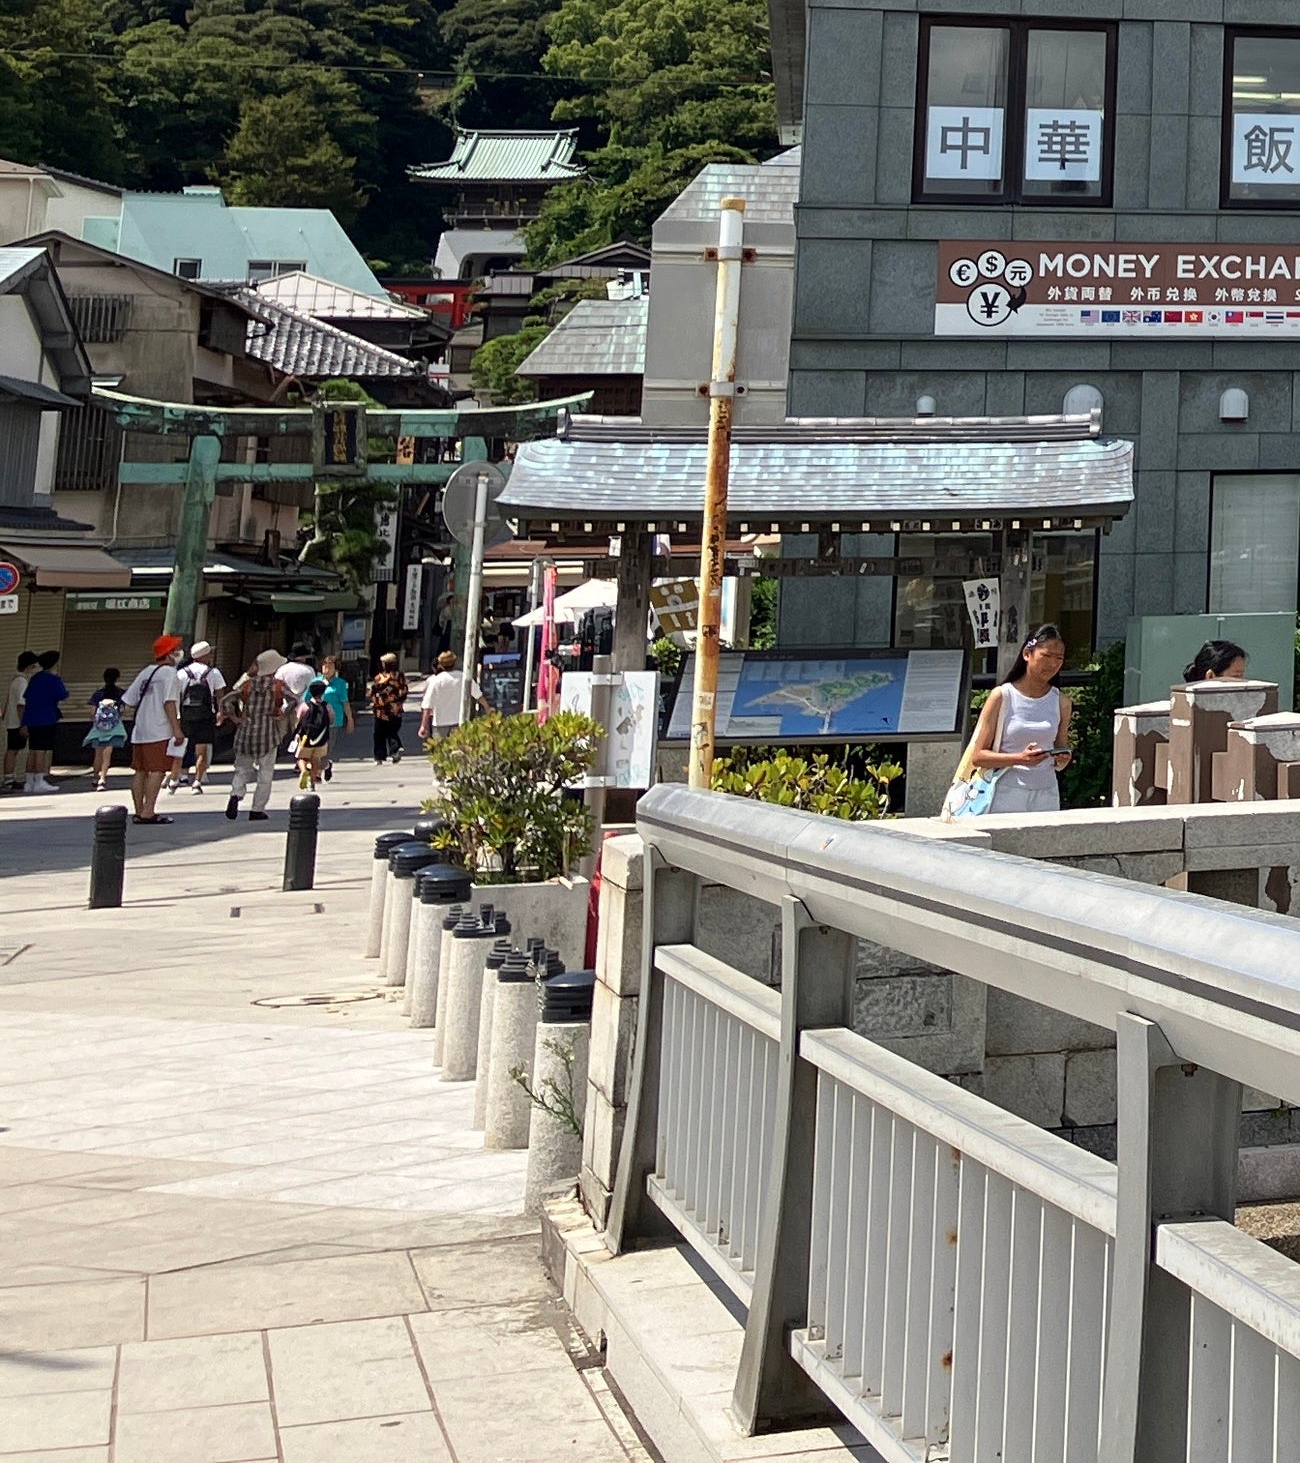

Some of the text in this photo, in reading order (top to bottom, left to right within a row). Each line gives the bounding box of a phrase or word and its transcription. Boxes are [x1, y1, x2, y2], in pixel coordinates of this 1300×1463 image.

[938, 115, 1091, 171] 中華
[1039, 253, 1160, 278] MONEY
[1047, 286, 1112, 301] 外貨両替
